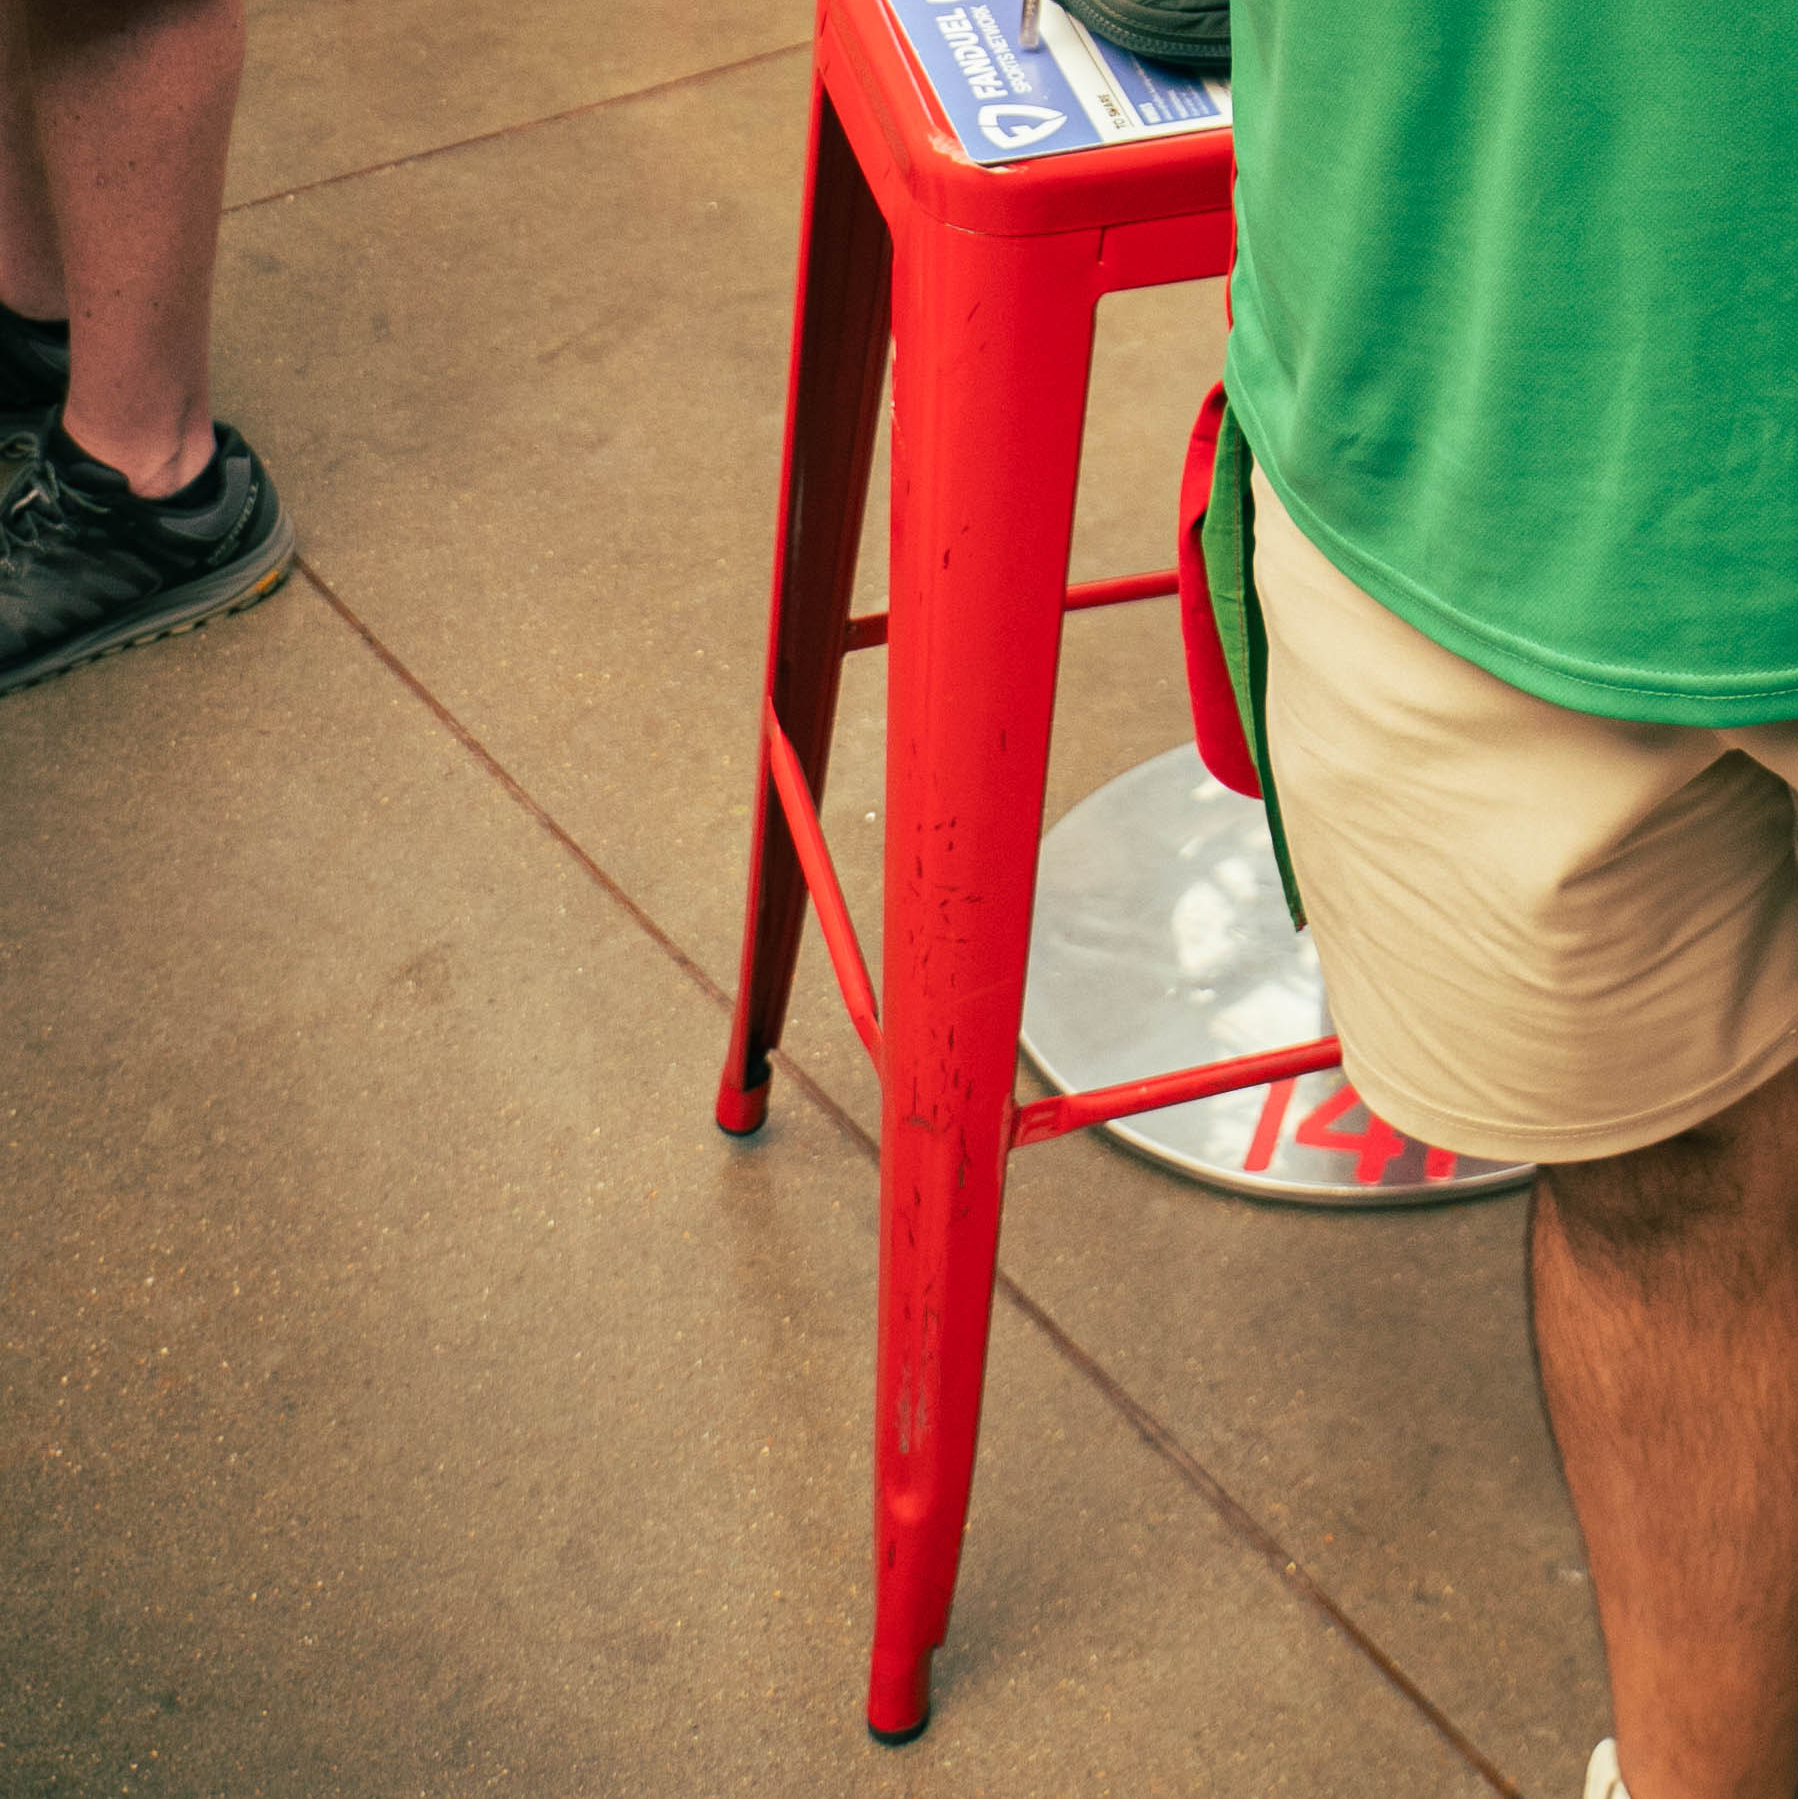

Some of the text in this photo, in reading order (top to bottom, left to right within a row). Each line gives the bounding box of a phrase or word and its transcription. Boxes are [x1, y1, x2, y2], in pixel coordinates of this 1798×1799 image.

[935, 8, 1009, 100] FANDUEL
[970, 4, 1033, 95] SPORTS NETWORK
